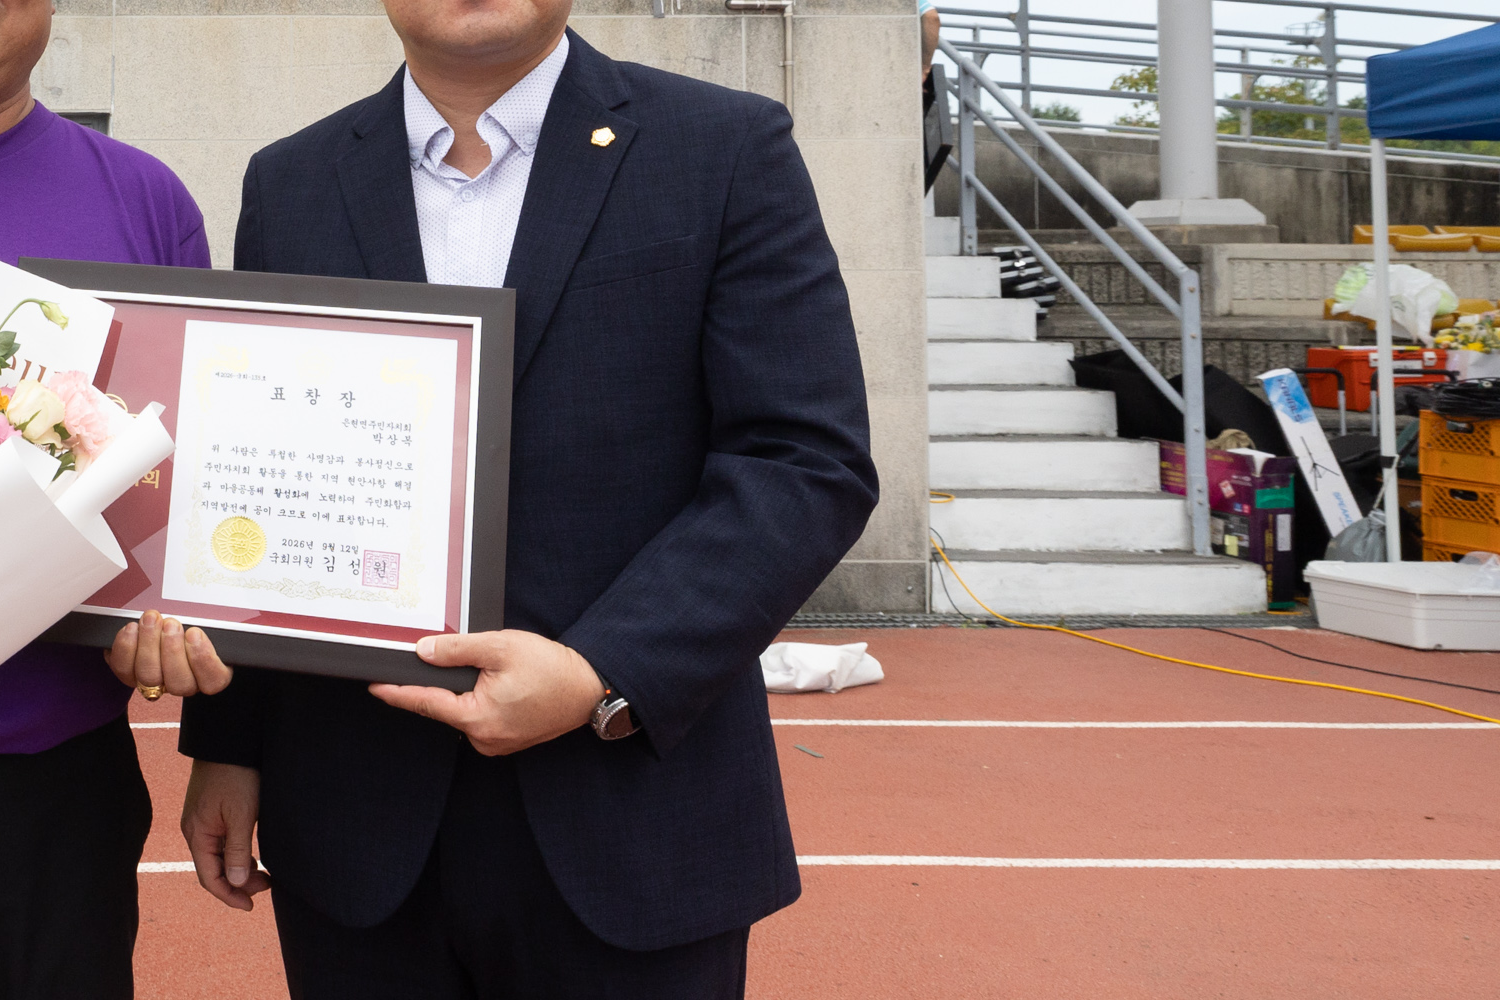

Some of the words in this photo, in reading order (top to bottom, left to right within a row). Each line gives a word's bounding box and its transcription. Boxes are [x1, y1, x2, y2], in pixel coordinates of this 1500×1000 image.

[212, 443, 220, 453] 위
[230, 445, 258, 458] 사람은
[306, 452, 345, 465] 사명감과
[355, 457, 414, 471] 봉사정신으로
[204, 461, 251, 475] 주민자치회
[258, 466, 287, 479] 활동을
[294, 470, 314, 482] 통한
[321, 473, 339, 484] 지역
[348, 475, 387, 489] 현안사항
[202, 480, 212, 491] 과
[220, 482, 264, 496] 마을공동체
[273, 487, 310, 500] 활성화에
[318, 493, 355, 505] 노력하여
[365, 497, 412, 511] 주민화합과
[201, 500, 248, 514] 지역발전에
[253, 505, 272, 516] 공이
[277, 508, 306, 519] 크므로
[312, 511, 331, 522] 이에
[336, 514, 389, 528] 표창합니다.
[269, 551, 314, 569] 국회의원
[281, 538, 314, 550] 2026년
[322, 542, 336, 553] 9월
[340, 544, 359, 555] 12일
